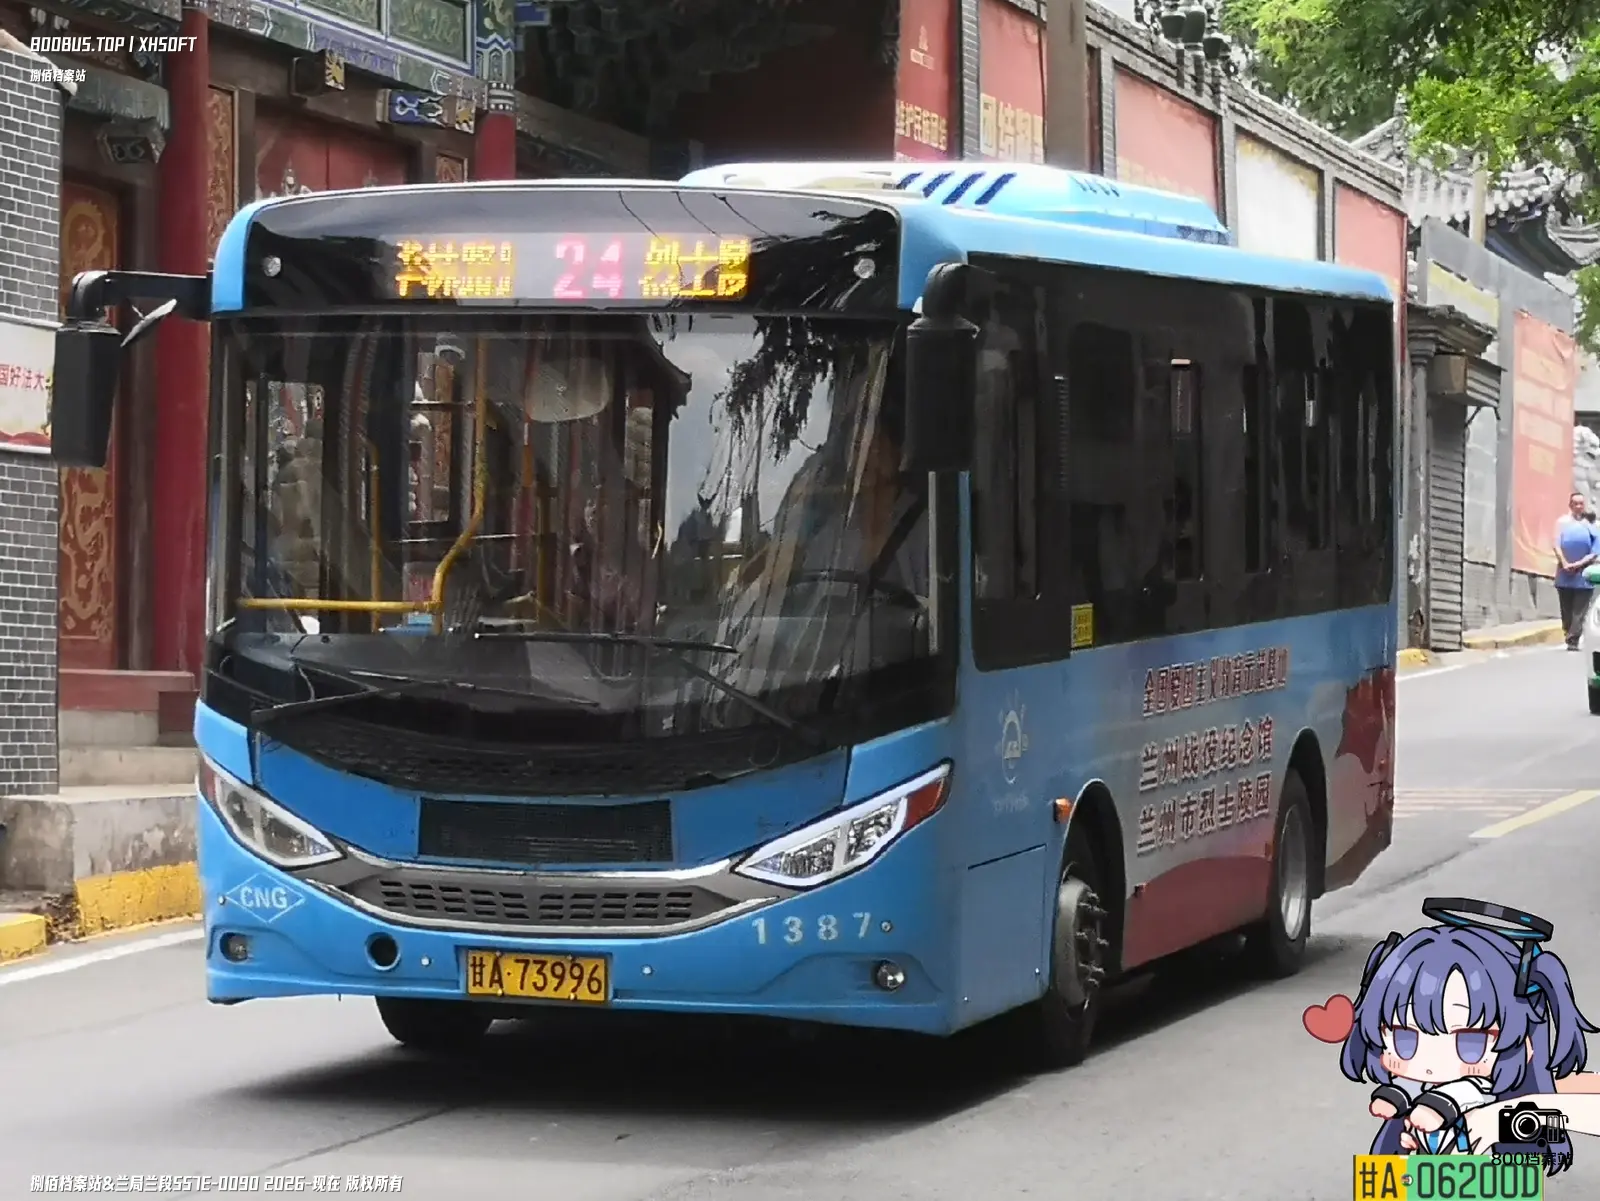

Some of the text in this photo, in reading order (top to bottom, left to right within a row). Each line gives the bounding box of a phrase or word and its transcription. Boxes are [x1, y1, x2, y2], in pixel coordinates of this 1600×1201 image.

[552, 236, 624, 299] 24
[1139, 714, 1273, 793] 兰州战役纪念馆
[1136, 771, 1273, 857] 兰州市烈士陵园
[240, 886, 288, 909] CNG
[751, 911, 872, 945] 1387
